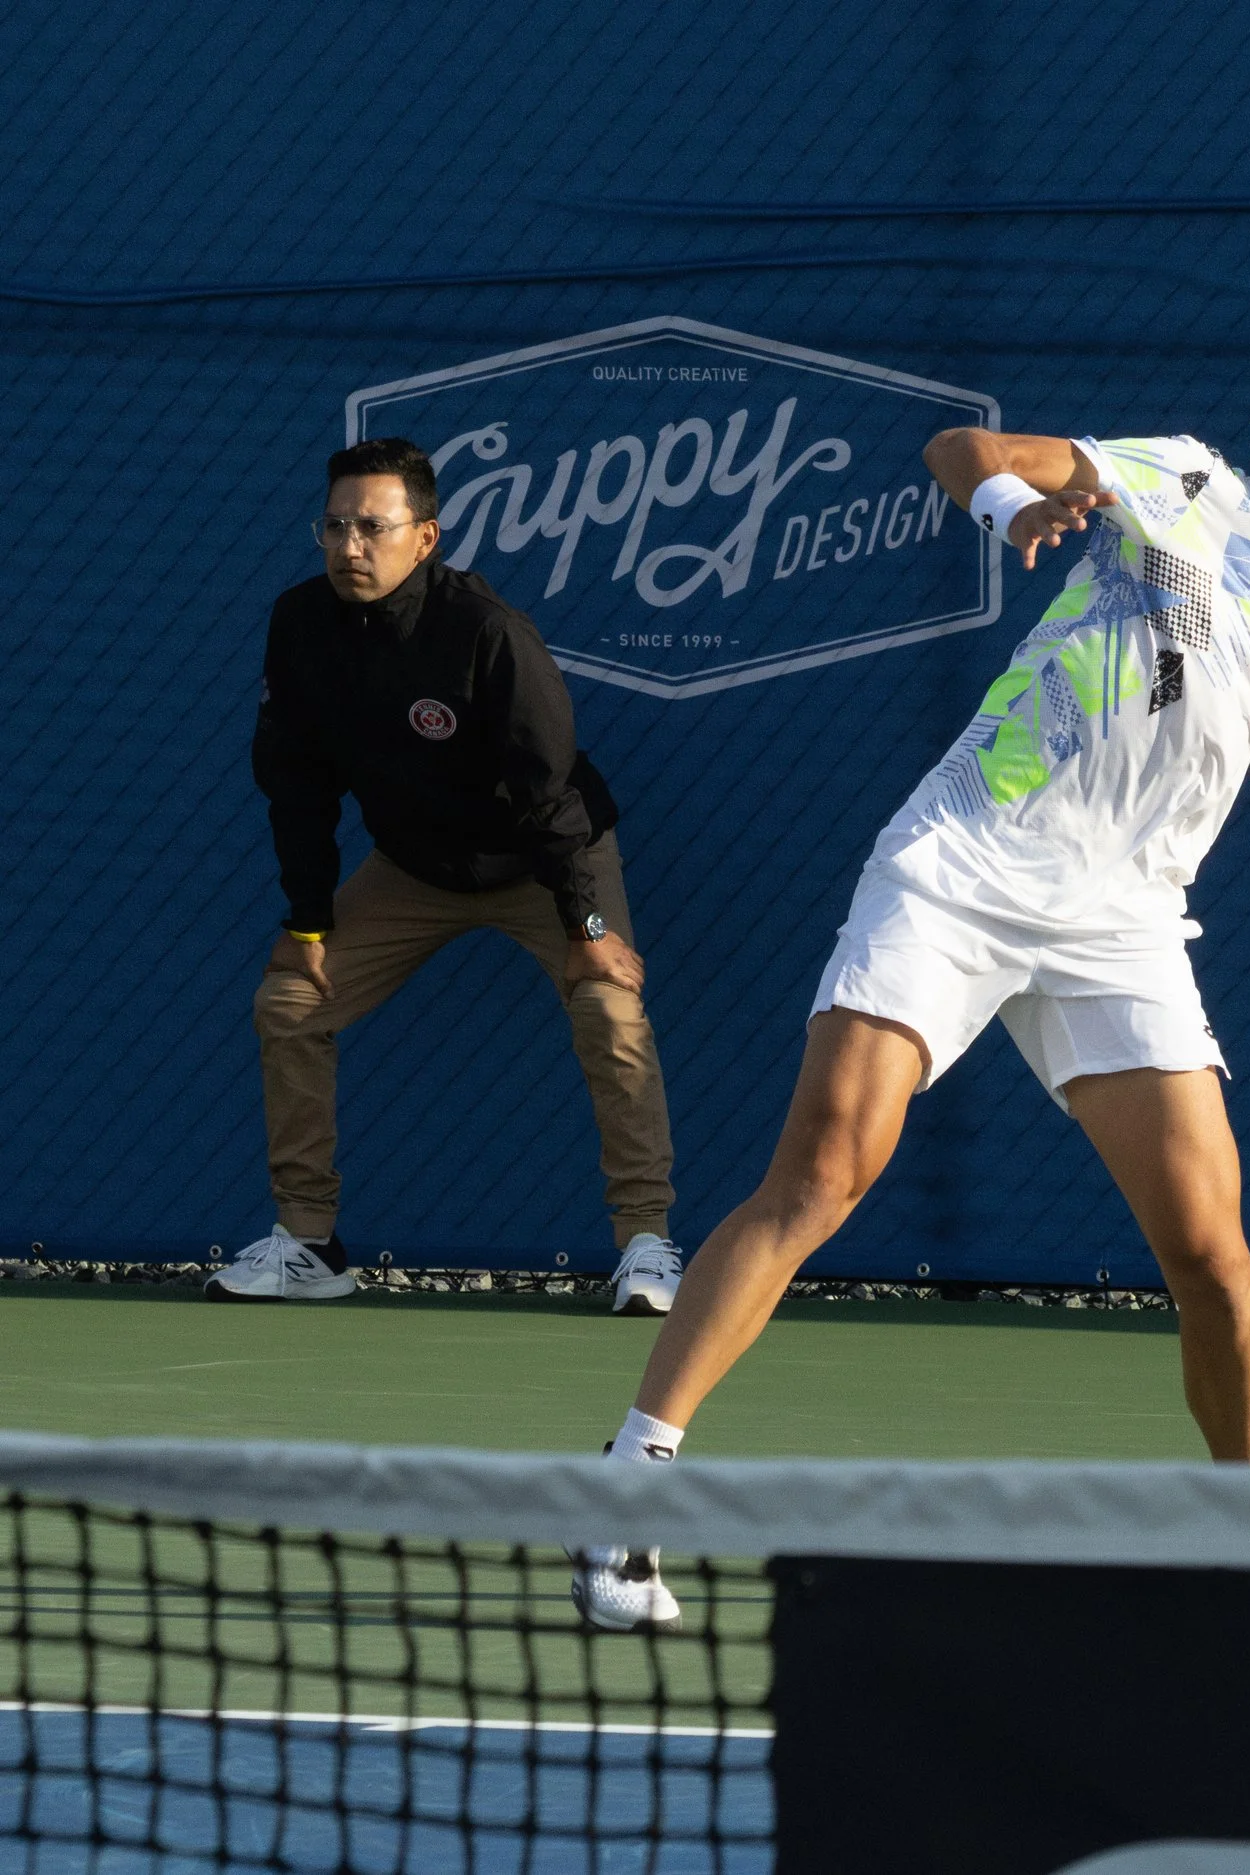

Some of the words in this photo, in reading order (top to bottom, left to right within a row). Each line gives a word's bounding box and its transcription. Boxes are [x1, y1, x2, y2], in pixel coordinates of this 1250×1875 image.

[593, 366, 663, 380] QUALITY
[668, 367, 748, 382] CREATIVE
[430, 397, 851, 607] Guppy
[774, 480, 949, 579] DESIGN
[619, 633, 673, 647] SINCE
[681, 634, 722, 648] 1999
